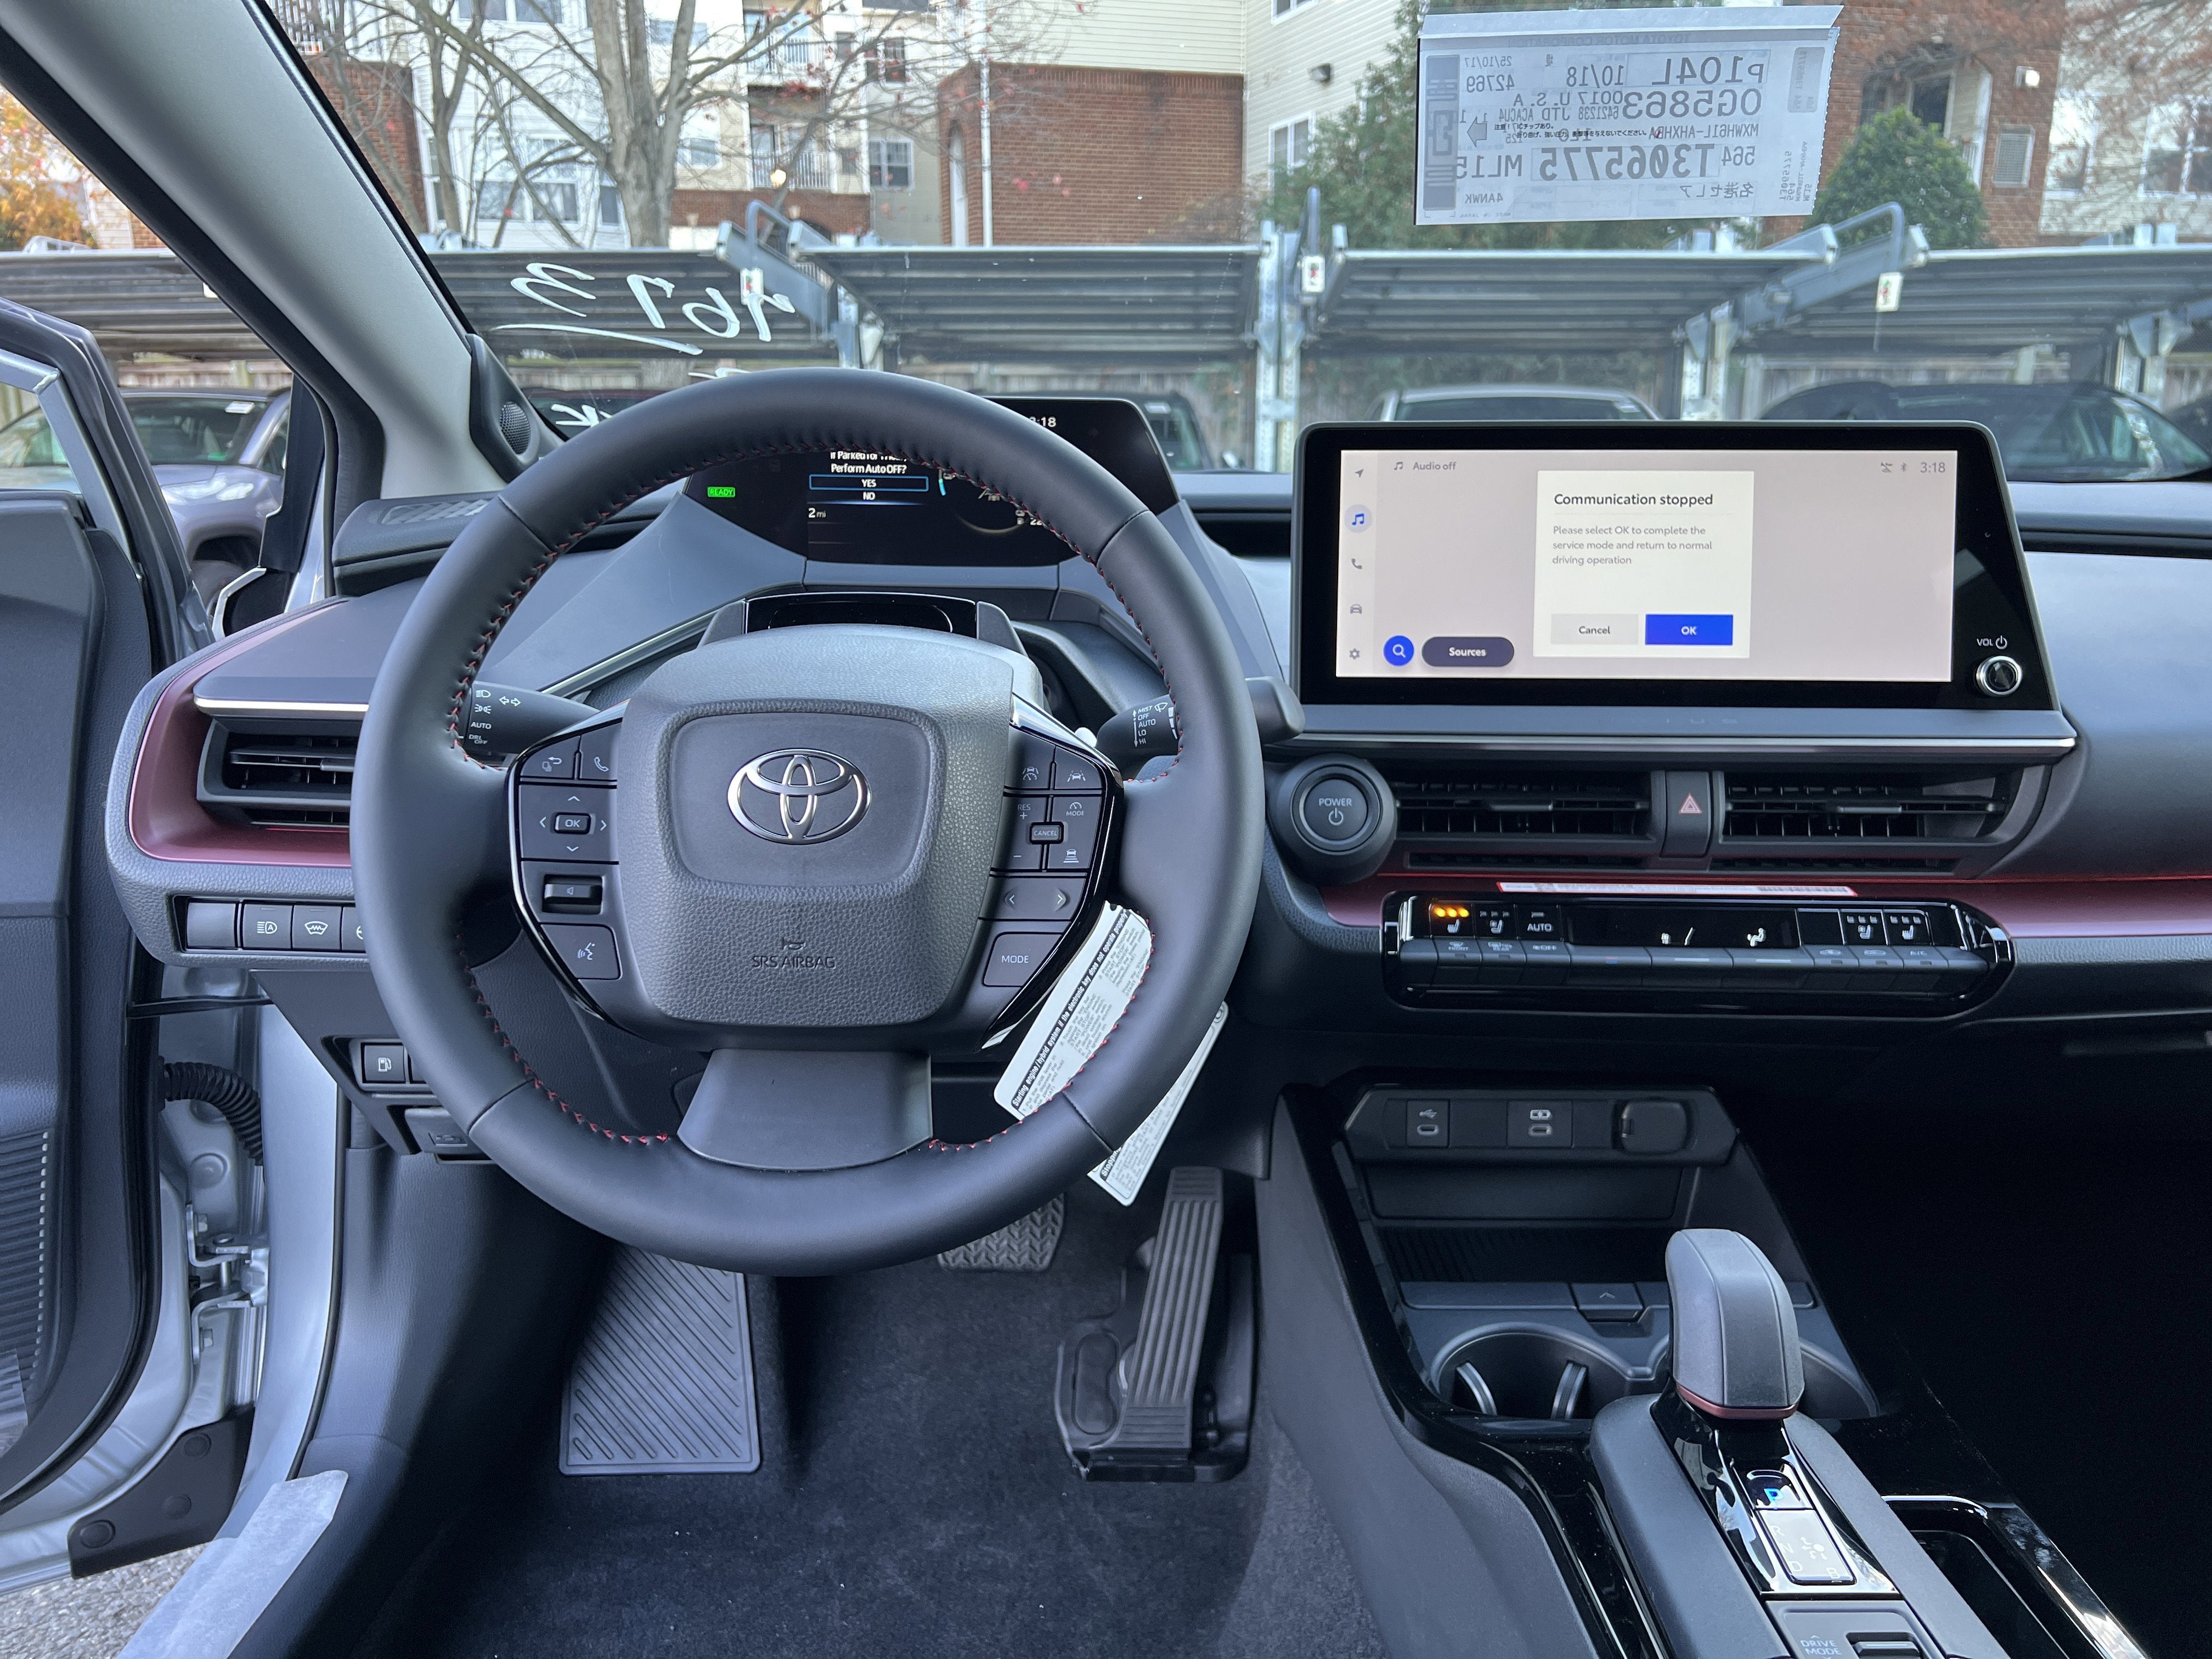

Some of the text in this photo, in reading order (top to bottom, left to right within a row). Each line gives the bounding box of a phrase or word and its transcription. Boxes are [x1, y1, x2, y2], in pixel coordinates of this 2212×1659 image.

[831, 463, 907, 474] Perform Auto OFF?
[1413, 461, 1457, 470] Audio off
[1920, 462, 1946, 473] 3:18
[861, 479, 877, 488] YES
[709, 488, 733, 496] READY
[862, 492, 876, 500] NO
[1554, 493, 1713, 507] Communication stopped
[808, 507, 826, 518] 2 mi
[1553, 526, 1706, 537] Please select OK to complete the
[1553, 541, 1584, 549] service
[1587, 540, 1614, 549] mode
[1616, 540, 1634, 549] and
[1667, 541, 1677, 549] to
[1679, 540, 1713, 549] normal
[1552, 555, 1632, 566] driving operation
[1578, 625, 1611, 635] Cancel
[1680, 625, 1698, 636] OK
[1977, 638, 1994, 646] VOL
[1448, 646, 1486, 657] Sources
[1137, 705, 1153, 714] MIST
[1137, 713, 1150, 721] OFF
[1138, 719, 1156, 728] AUTO
[1318, 798, 1352, 806] POWER
[565, 819, 580, 828] OK
[1527, 923, 1553, 932] AUTO
[752, 955, 837, 969] SRS AIRBAG
[1001, 955, 1029, 964] MODE
[1012, 1084, 1029, 1107] Starting
[1047, 1025, 1062, 1047] system
[1060, 1010, 1070, 1021] the
[1066, 985, 1085, 1012] electronic
[1081, 974, 1092, 987] key
[1087, 961, 1098, 976] does
[1096, 951, 1104, 962] not
[1102, 932, 1116, 953] operate
[1763, 1487, 1784, 1507] P
[1769, 1525, 1785, 1536] R
[1779, 1542, 1795, 1554] N
[1789, 1560, 1803, 1572] D
[1826, 1567, 1841, 1579] B
